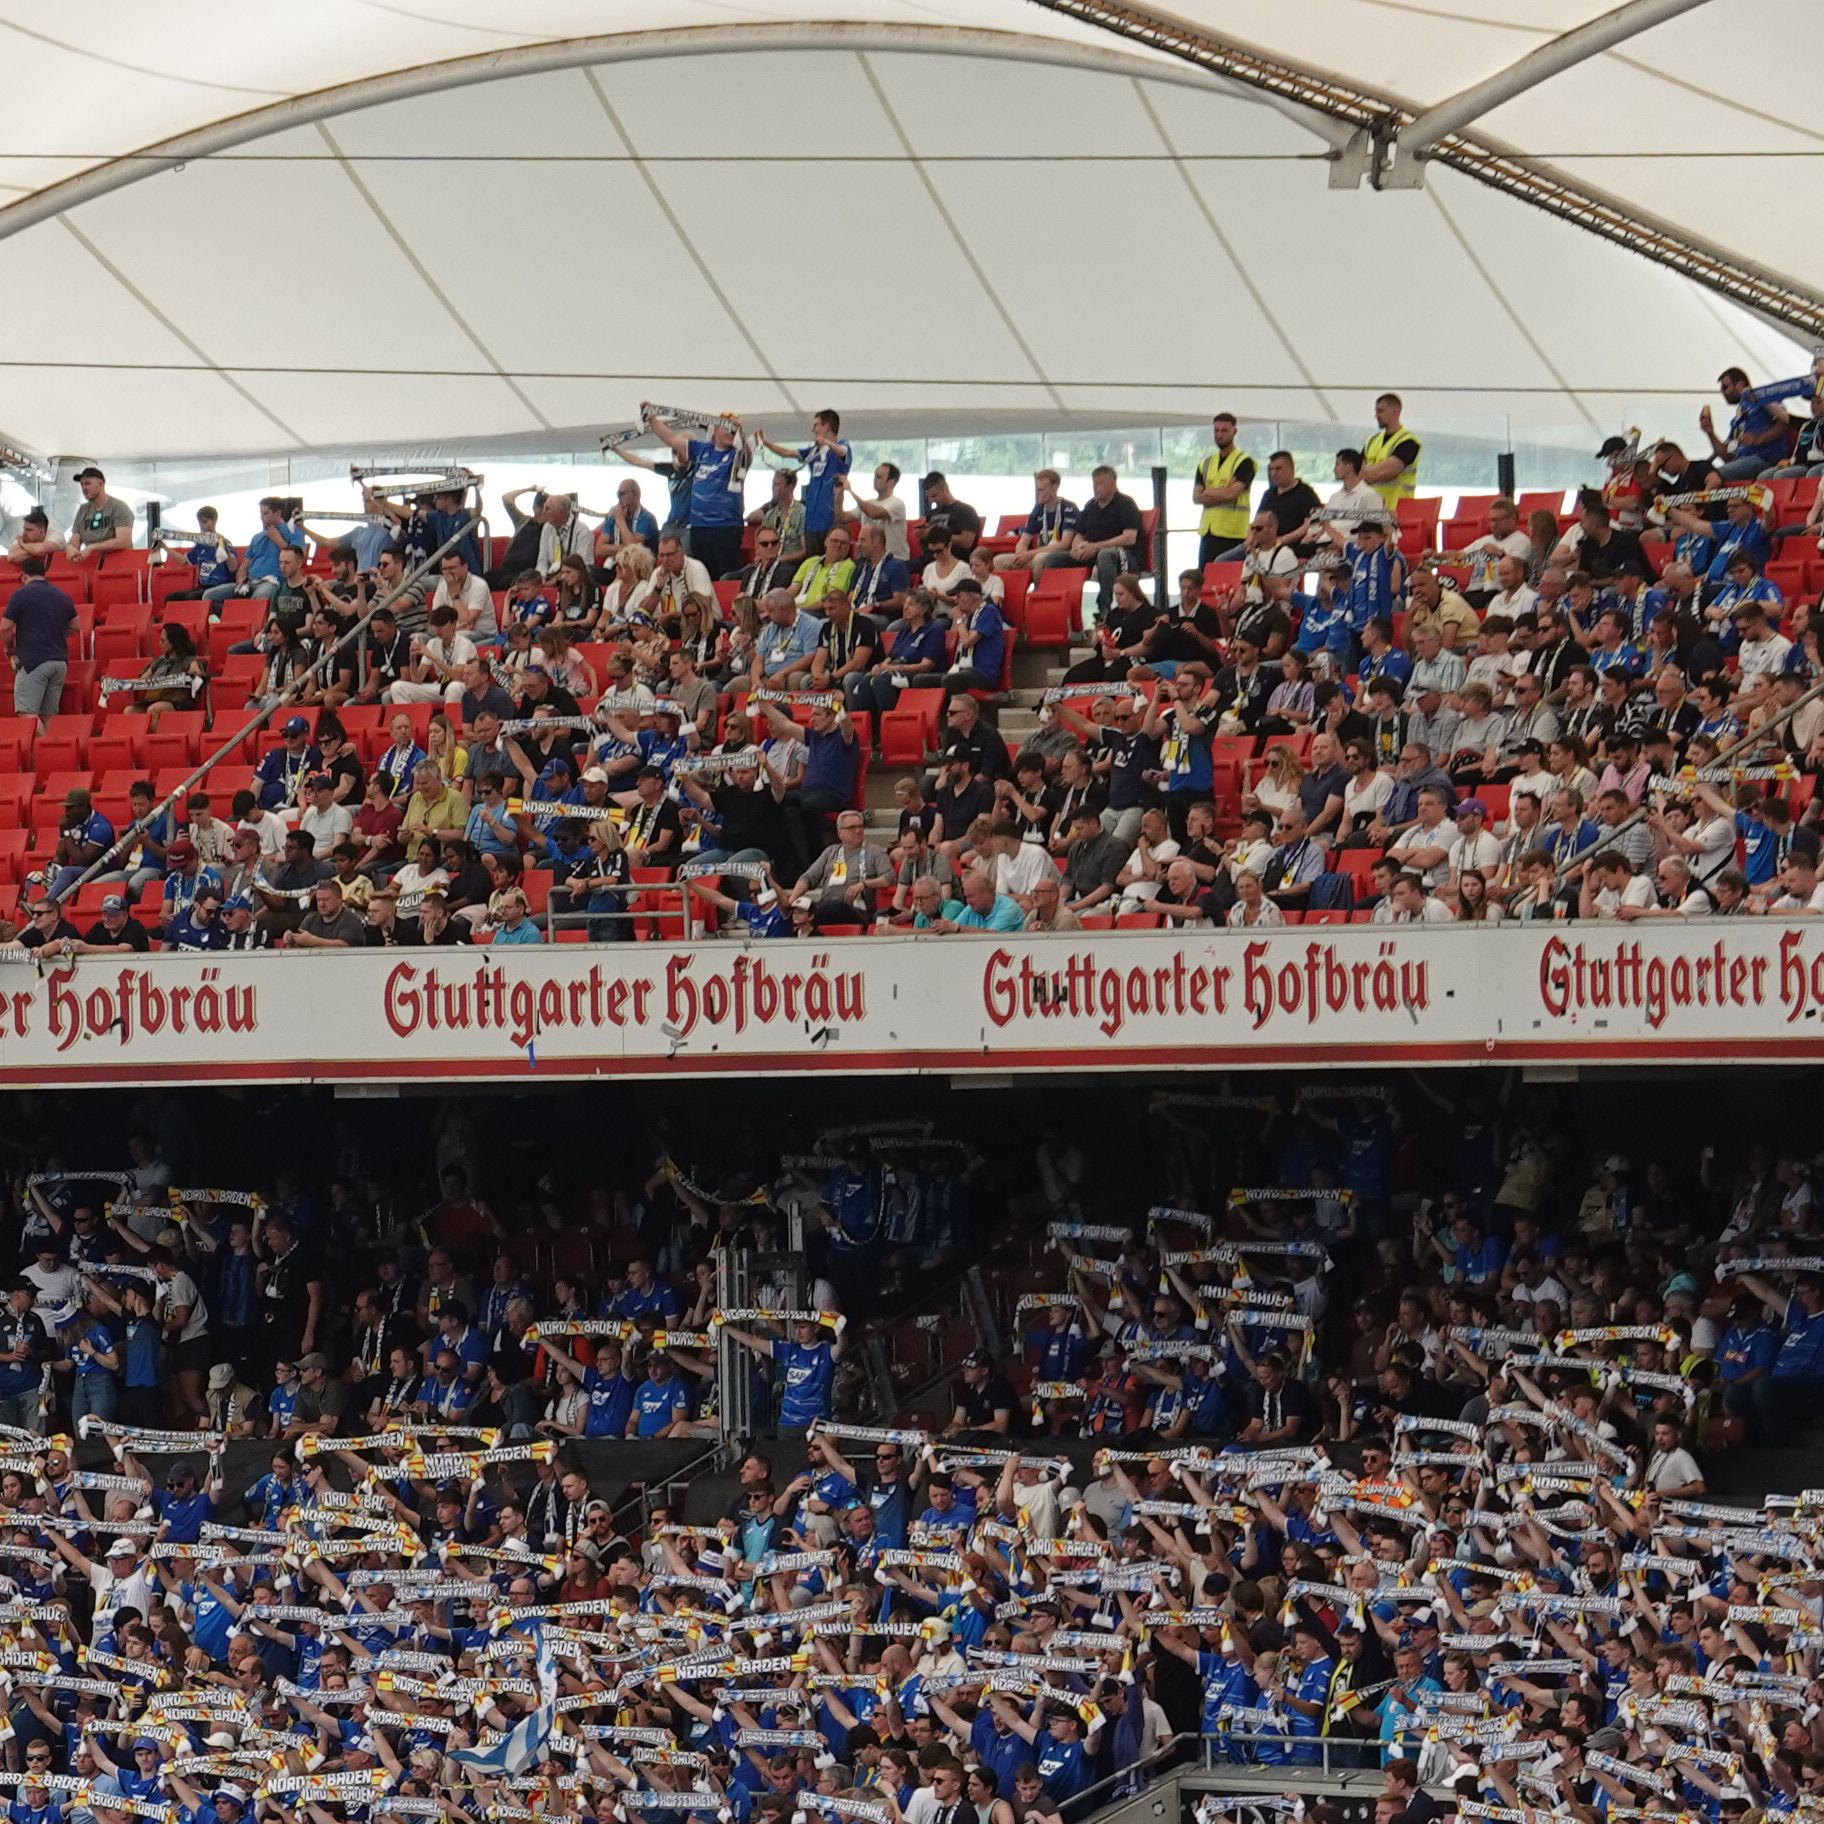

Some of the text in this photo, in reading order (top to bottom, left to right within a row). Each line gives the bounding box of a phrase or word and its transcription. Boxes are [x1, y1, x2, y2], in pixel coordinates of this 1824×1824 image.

[982, 939, 1431, 1038] Stuttgarter Hofbräu
[1539, 934, 1765, 1031] Stuttgarter
[45, 965, 261, 1052] Hofbräu
[383, 953, 868, 1047] Stuttgarter Hofbräu
[536, 1321, 621, 1336] NORD BADEN
[786, 1367, 813, 1383] SAP
[424, 1444, 531, 1467] NORD BADEN
[511, 1599, 610, 1617] NORD BADEN
[676, 1658, 790, 1679] NORD BADEN
[1020, 1654, 1085, 1670] HOFFENHEIM
[163, 1707, 251, 1726] NORD BADEN
[42, 1774, 89, 1791] BADEN
[267, 1770, 372, 1793] NORD BADEN
[659, 1793, 720, 1809] HOFFENHEIM
